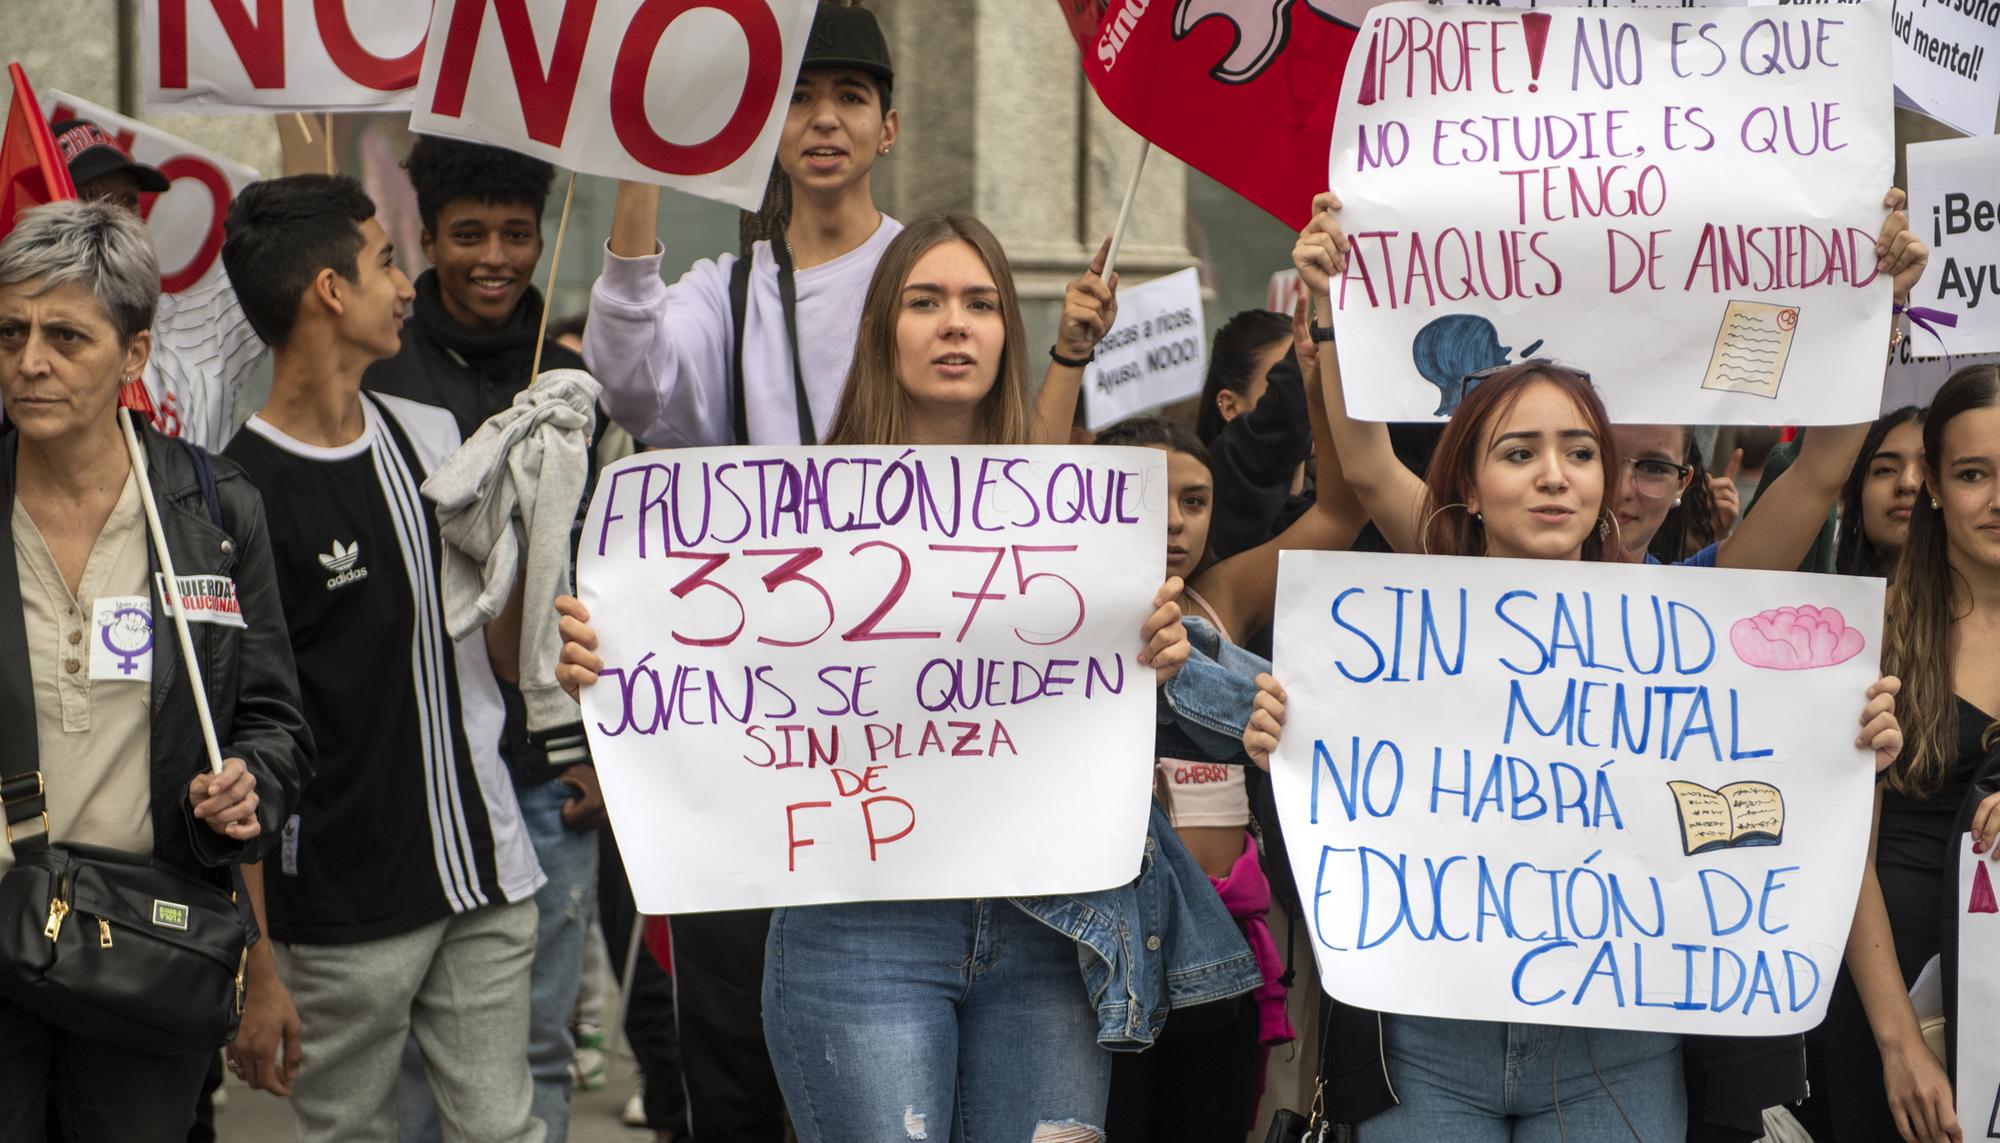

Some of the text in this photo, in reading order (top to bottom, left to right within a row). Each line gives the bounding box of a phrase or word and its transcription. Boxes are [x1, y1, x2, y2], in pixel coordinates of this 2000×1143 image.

[158, 0, 426, 92] NO
[431, 0, 783, 176] NO
[1357, 12, 1844, 106] ¡PROFE! NO ES QUE
[1913, 28, 1985, 82] mental!
[1357, 101, 1849, 172] NO ESTUDIE, ES QUE
[1500, 165, 1668, 225] TENGO
[1933, 193, 2000, 247] ¡Be
[1338, 227, 1563, 311] ATAQUES
[1607, 229, 1673, 295] DE
[1684, 222, 1881, 293] ANSIEDAD
[598, 448, 1140, 558] FRUSTRACIÓN ES QUE
[327, 566, 368, 588] adidas
[665, 540, 1087, 648] 33275
[1331, 586, 1716, 683] SIN SALUD
[597, 651, 1125, 737] JÓVENS SE QUEDEN
[1503, 677, 1774, 763] MENTAL
[743, 718, 1018, 770] SIN PLAZA
[830, 764, 888, 798] DE
[1174, 763, 1229, 784] CHERRY
[1310, 735, 1625, 830] NO HABRÁ
[1313, 845, 1801, 952] EDUCACIÓN DE
[1510, 941, 1821, 1016] CALIDAD
